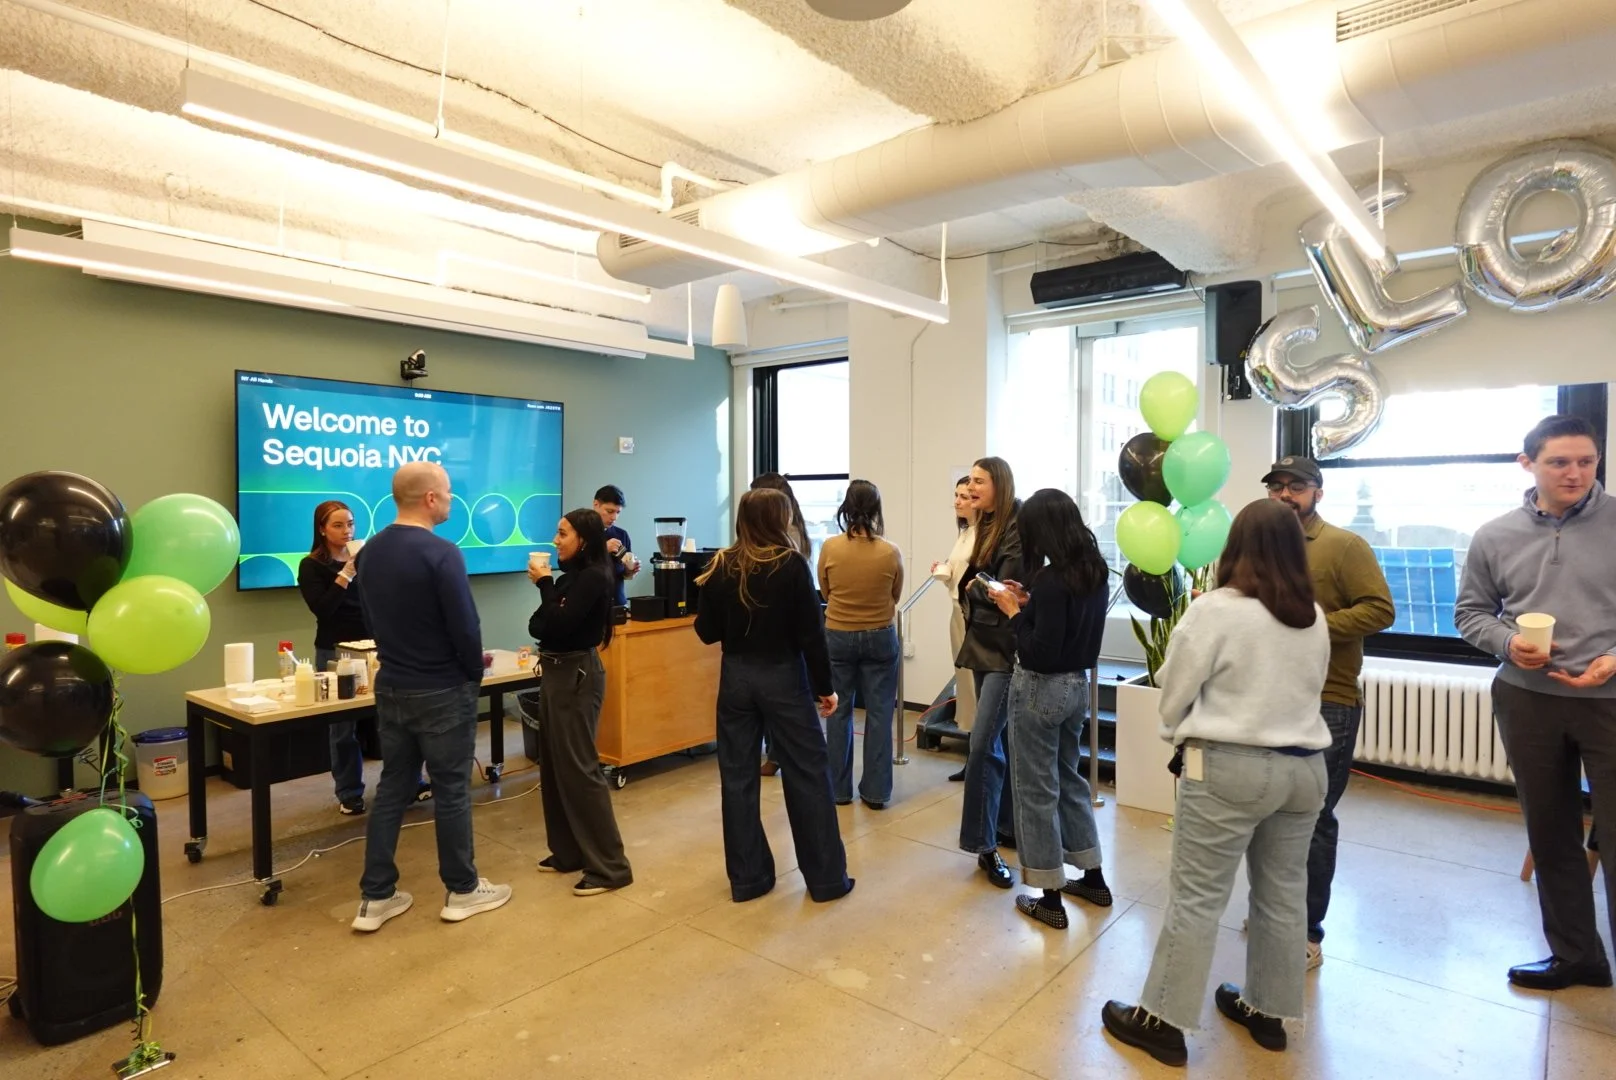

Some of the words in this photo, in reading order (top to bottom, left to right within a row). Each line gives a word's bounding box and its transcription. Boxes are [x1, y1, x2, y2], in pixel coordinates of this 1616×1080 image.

[262, 402, 397, 436] Welcome
[403, 415, 430, 438] to
[263, 438, 382, 471] Sequoia
[388, 444, 442, 468] NYC
